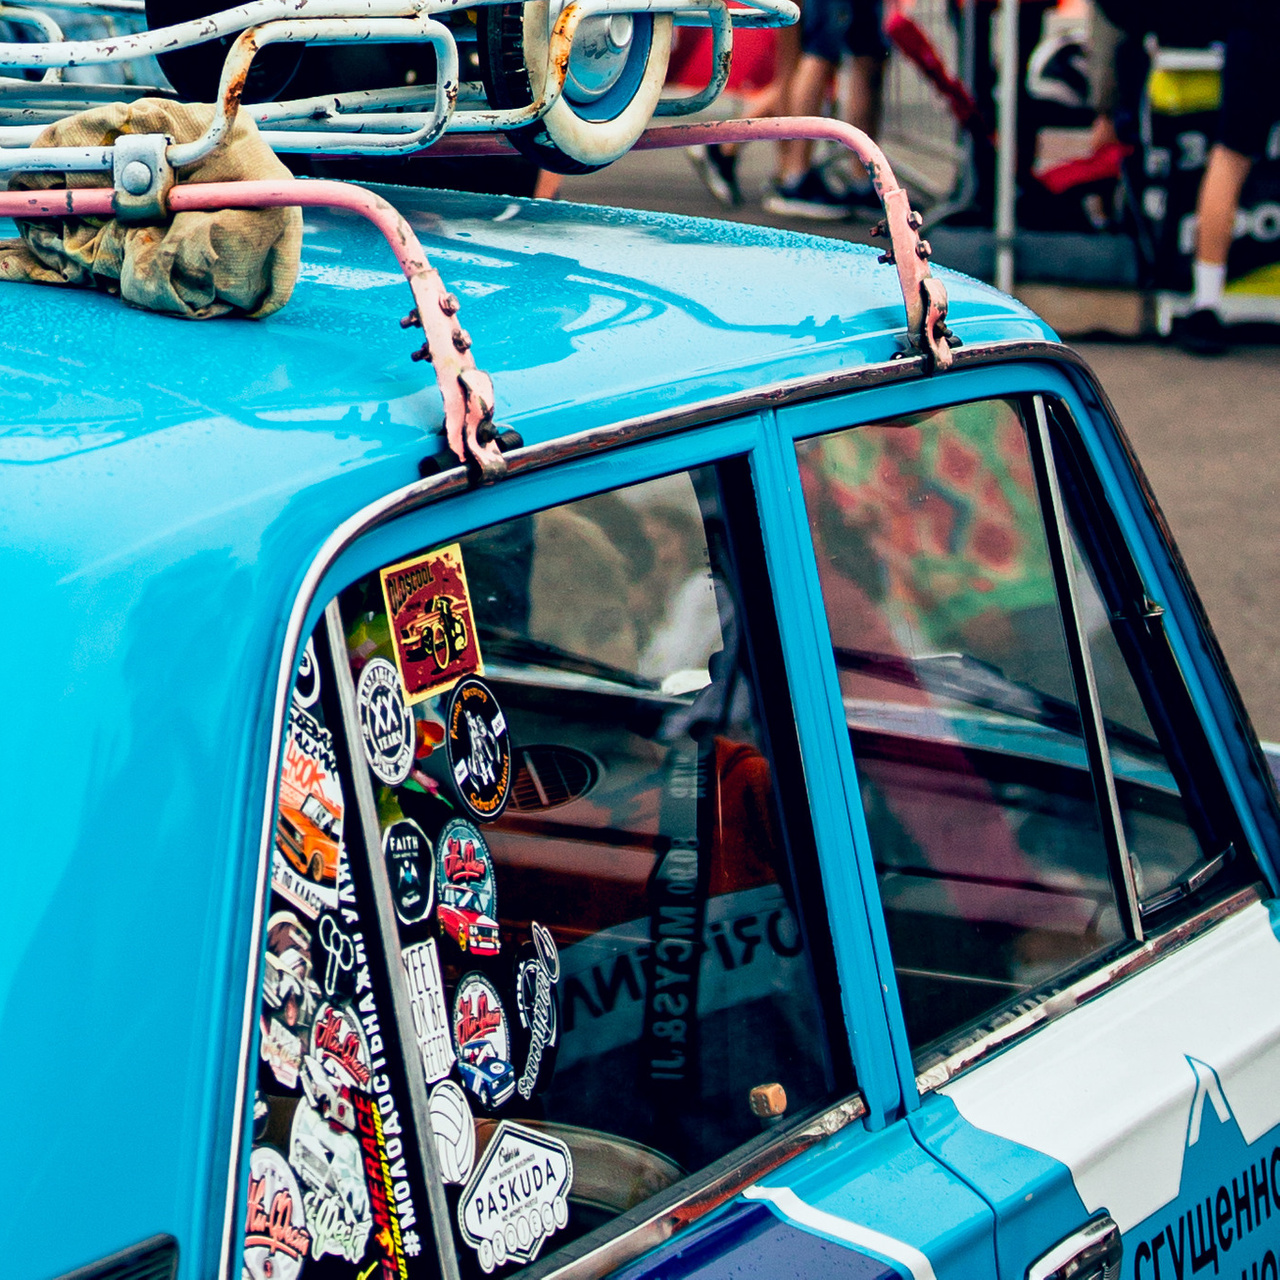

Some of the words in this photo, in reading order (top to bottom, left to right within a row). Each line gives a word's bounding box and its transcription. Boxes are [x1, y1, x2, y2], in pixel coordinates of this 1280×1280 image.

[369, 691, 399, 731] XX
[377, 728, 403, 752] YEARS
[389, 835, 419, 852] FAITH
[474, 1157, 557, 1225] PASKUDA
[481, 1197, 564, 1262] PROJECT
